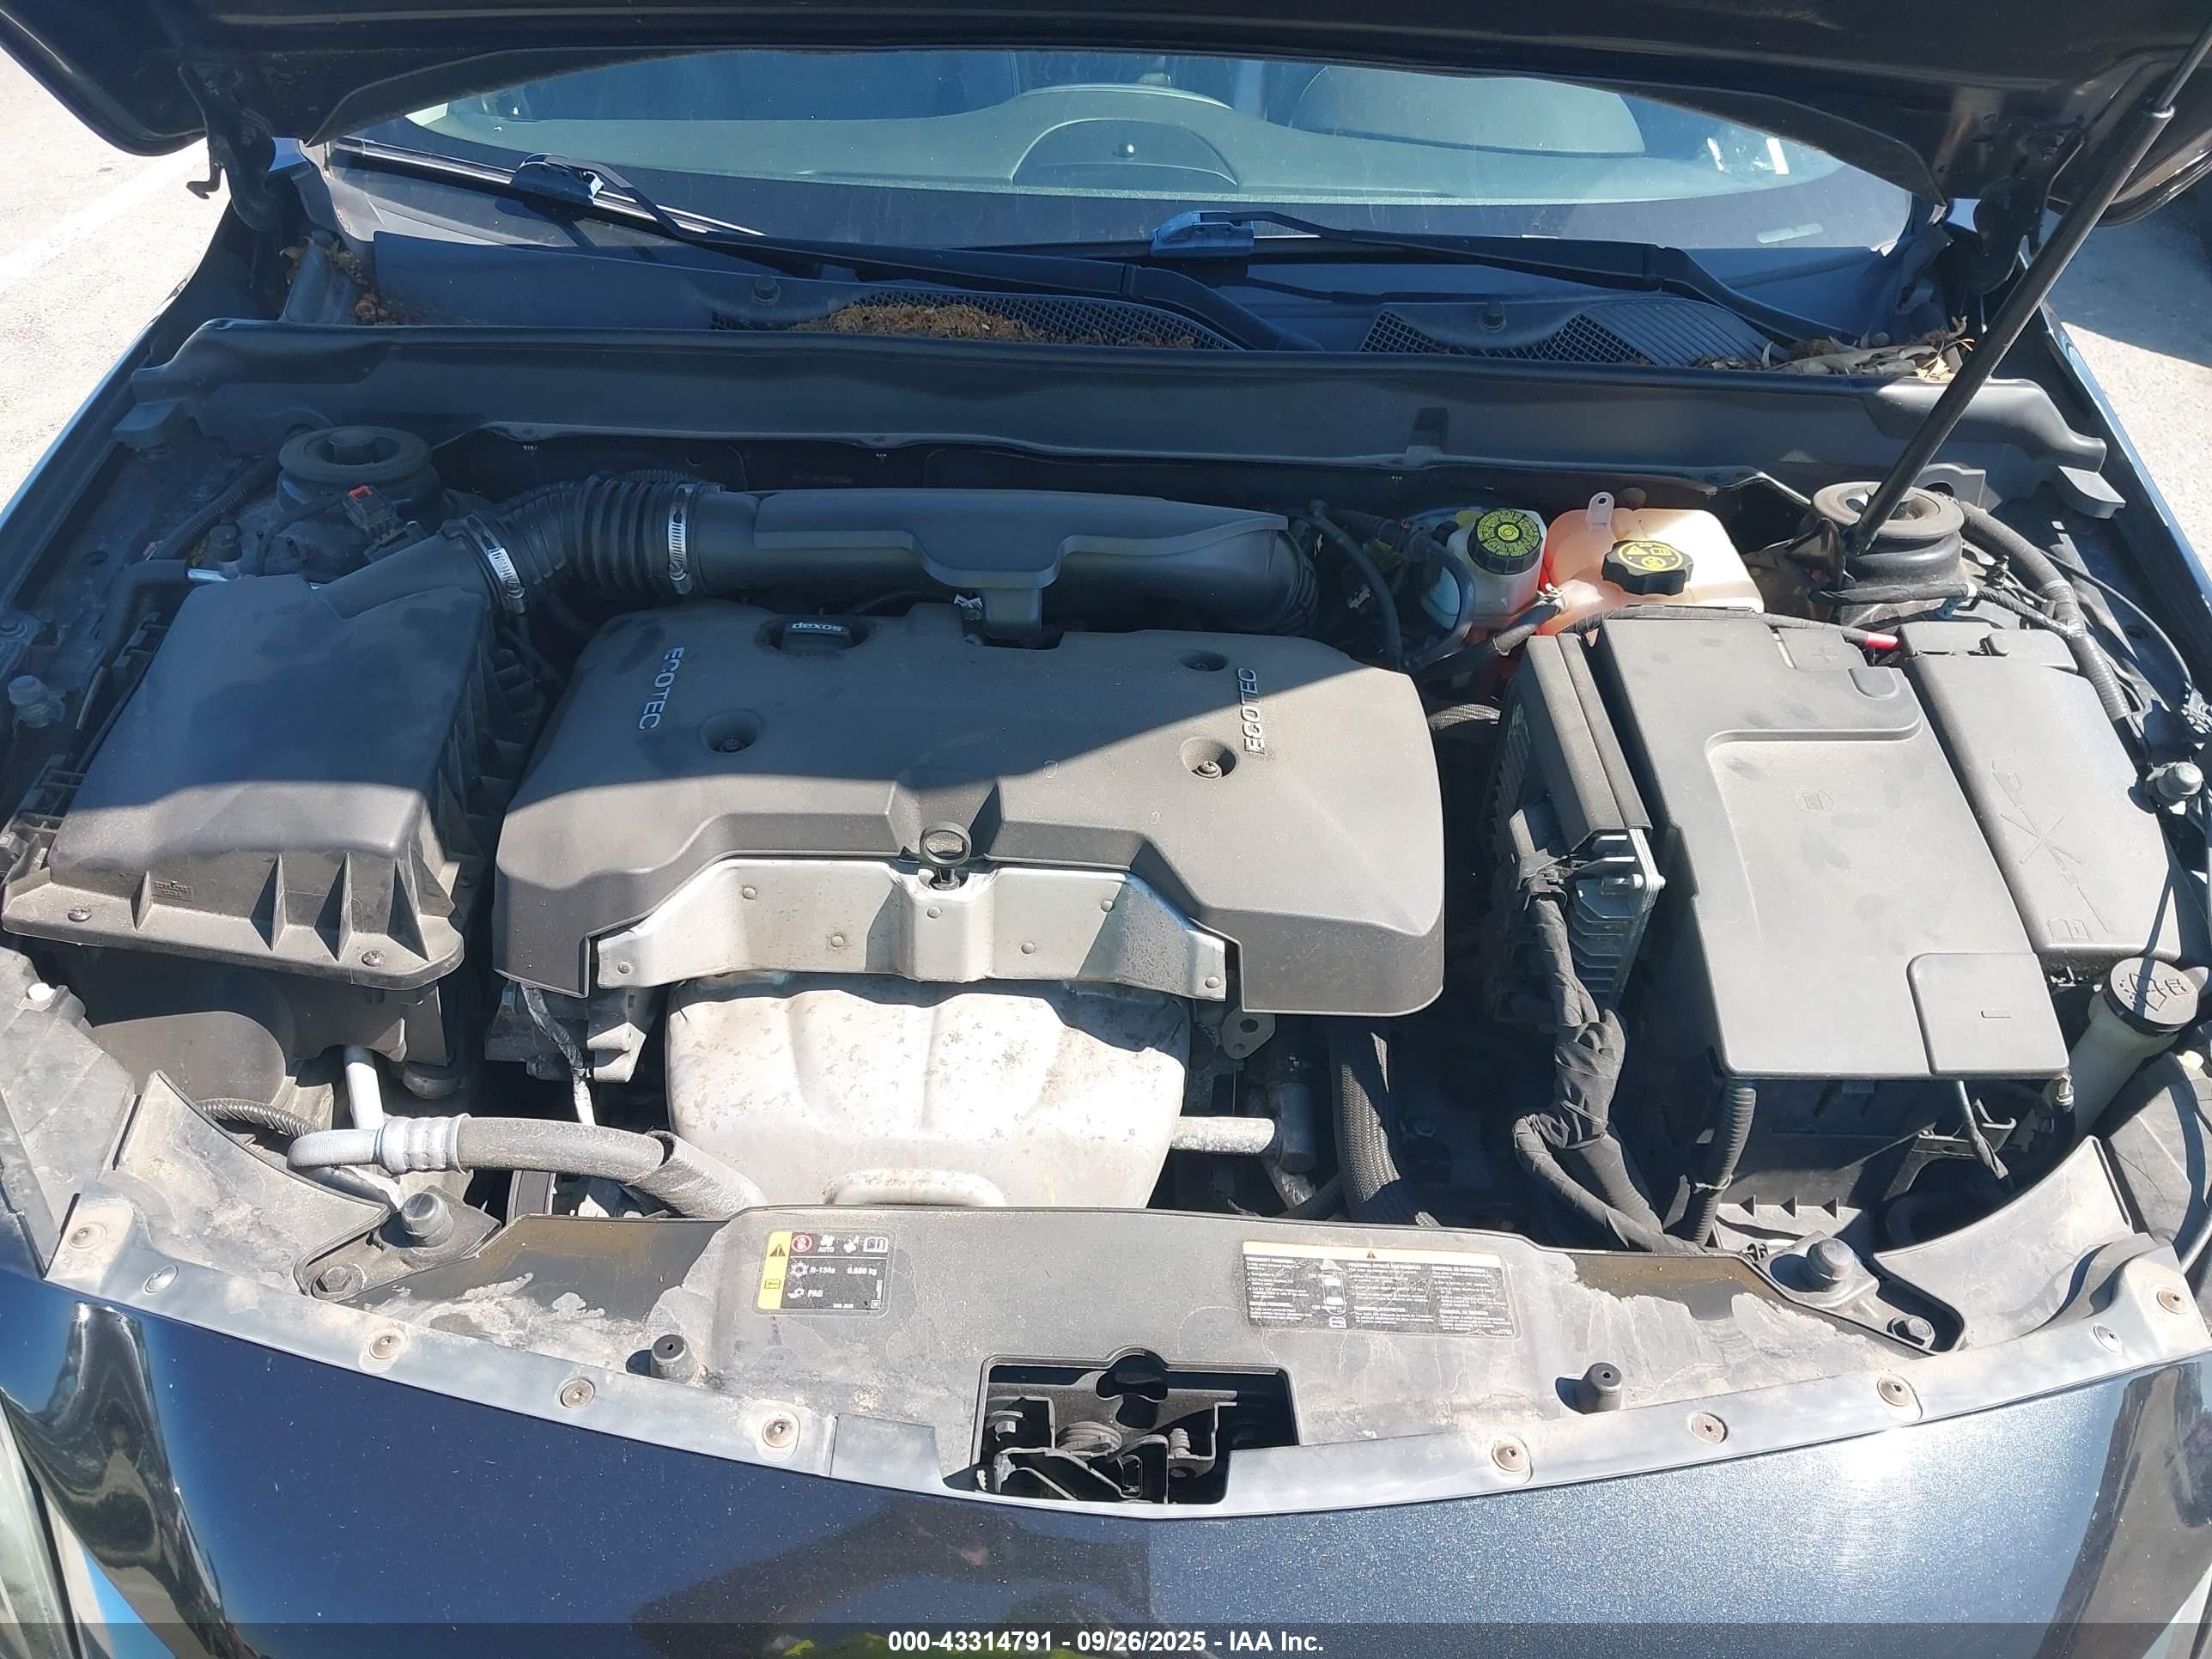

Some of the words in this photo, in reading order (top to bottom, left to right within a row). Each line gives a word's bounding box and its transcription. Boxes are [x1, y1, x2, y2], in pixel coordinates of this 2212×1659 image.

[792, 621, 844, 632] dexos
[638, 645, 686, 731] ECOTEC
[1237, 667, 1266, 755] ECOTEC
[807, 1289, 823, 1298] PAG
